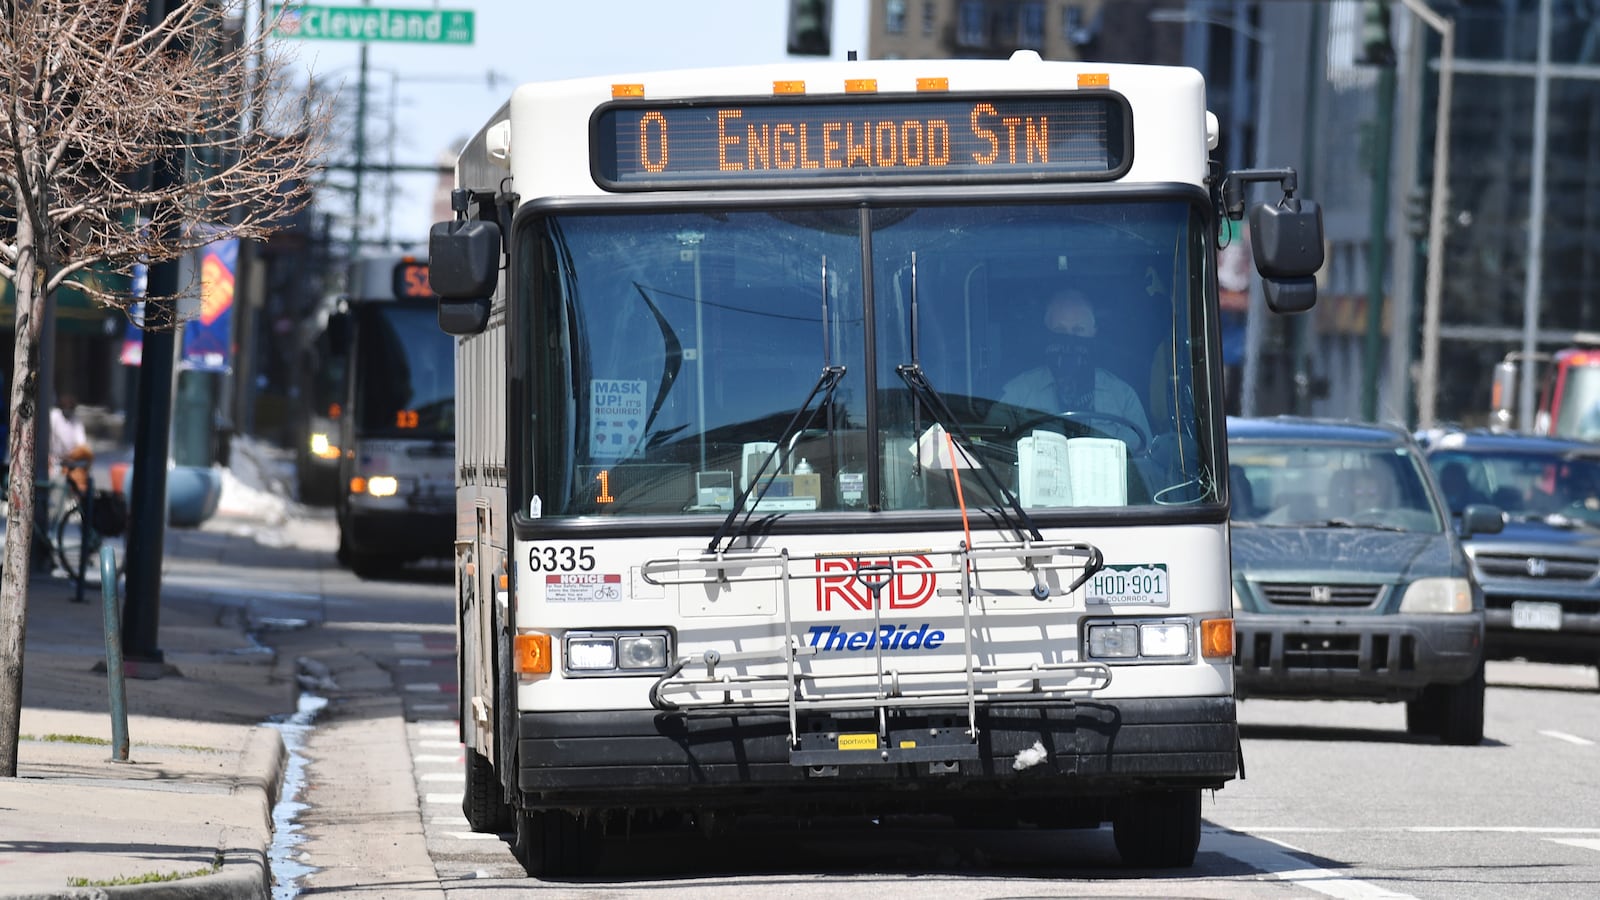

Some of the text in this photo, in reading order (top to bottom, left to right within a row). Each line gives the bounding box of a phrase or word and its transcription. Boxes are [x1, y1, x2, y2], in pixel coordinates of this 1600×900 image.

[304, 9, 443, 40] Cleveland
[595, 382, 641, 394] MASK
[595, 395, 622, 407] UP!
[595, 407, 641, 416] REQUIRED!
[596, 470, 614, 503] 1
[529, 546, 595, 572] 6335
[560, 574, 605, 584] NOTICE
[815, 554, 937, 611] RTD
[1106, 595, 1148, 603] COLORADO
[808, 623, 945, 652] TheRide
[839, 738, 876, 746] sportworks
